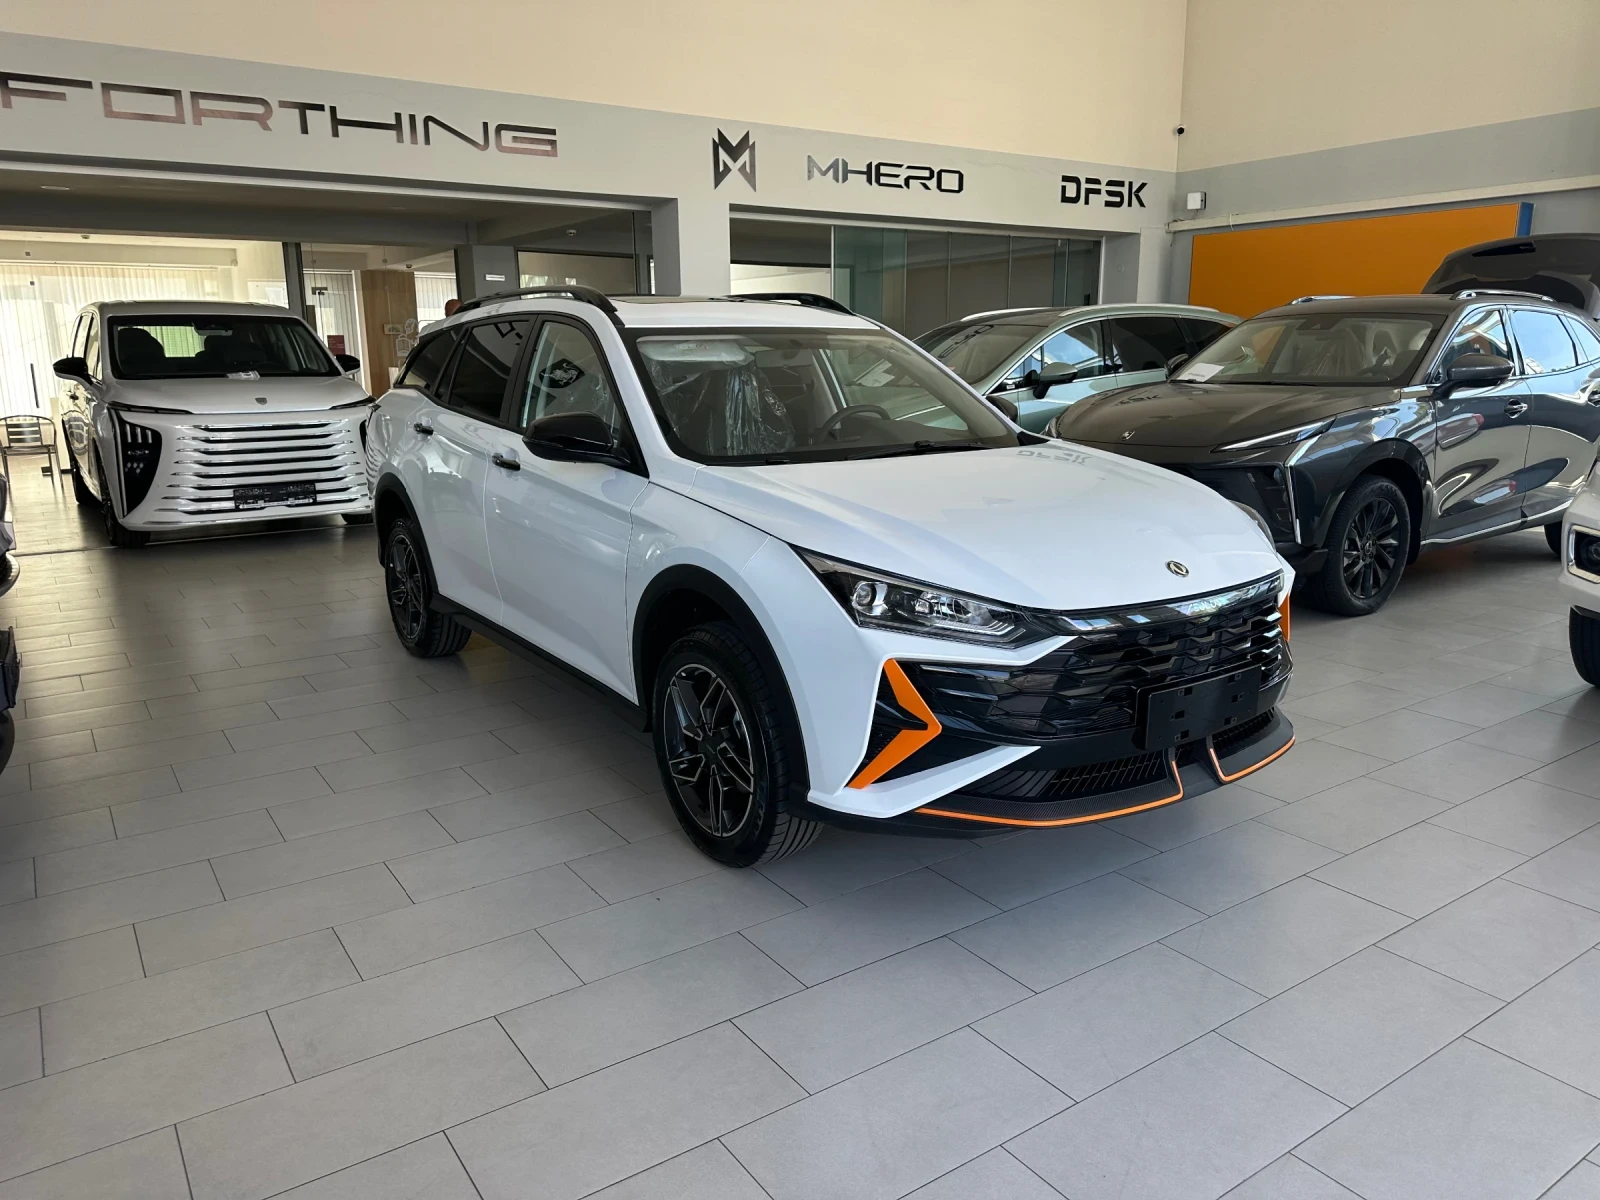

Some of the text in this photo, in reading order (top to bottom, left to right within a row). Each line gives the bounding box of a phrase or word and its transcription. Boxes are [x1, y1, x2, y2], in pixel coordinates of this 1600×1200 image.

[0, 71, 558, 158] FORTHING
[807, 154, 964, 194] MHERO
[1060, 175, 1148, 208] DFSK
